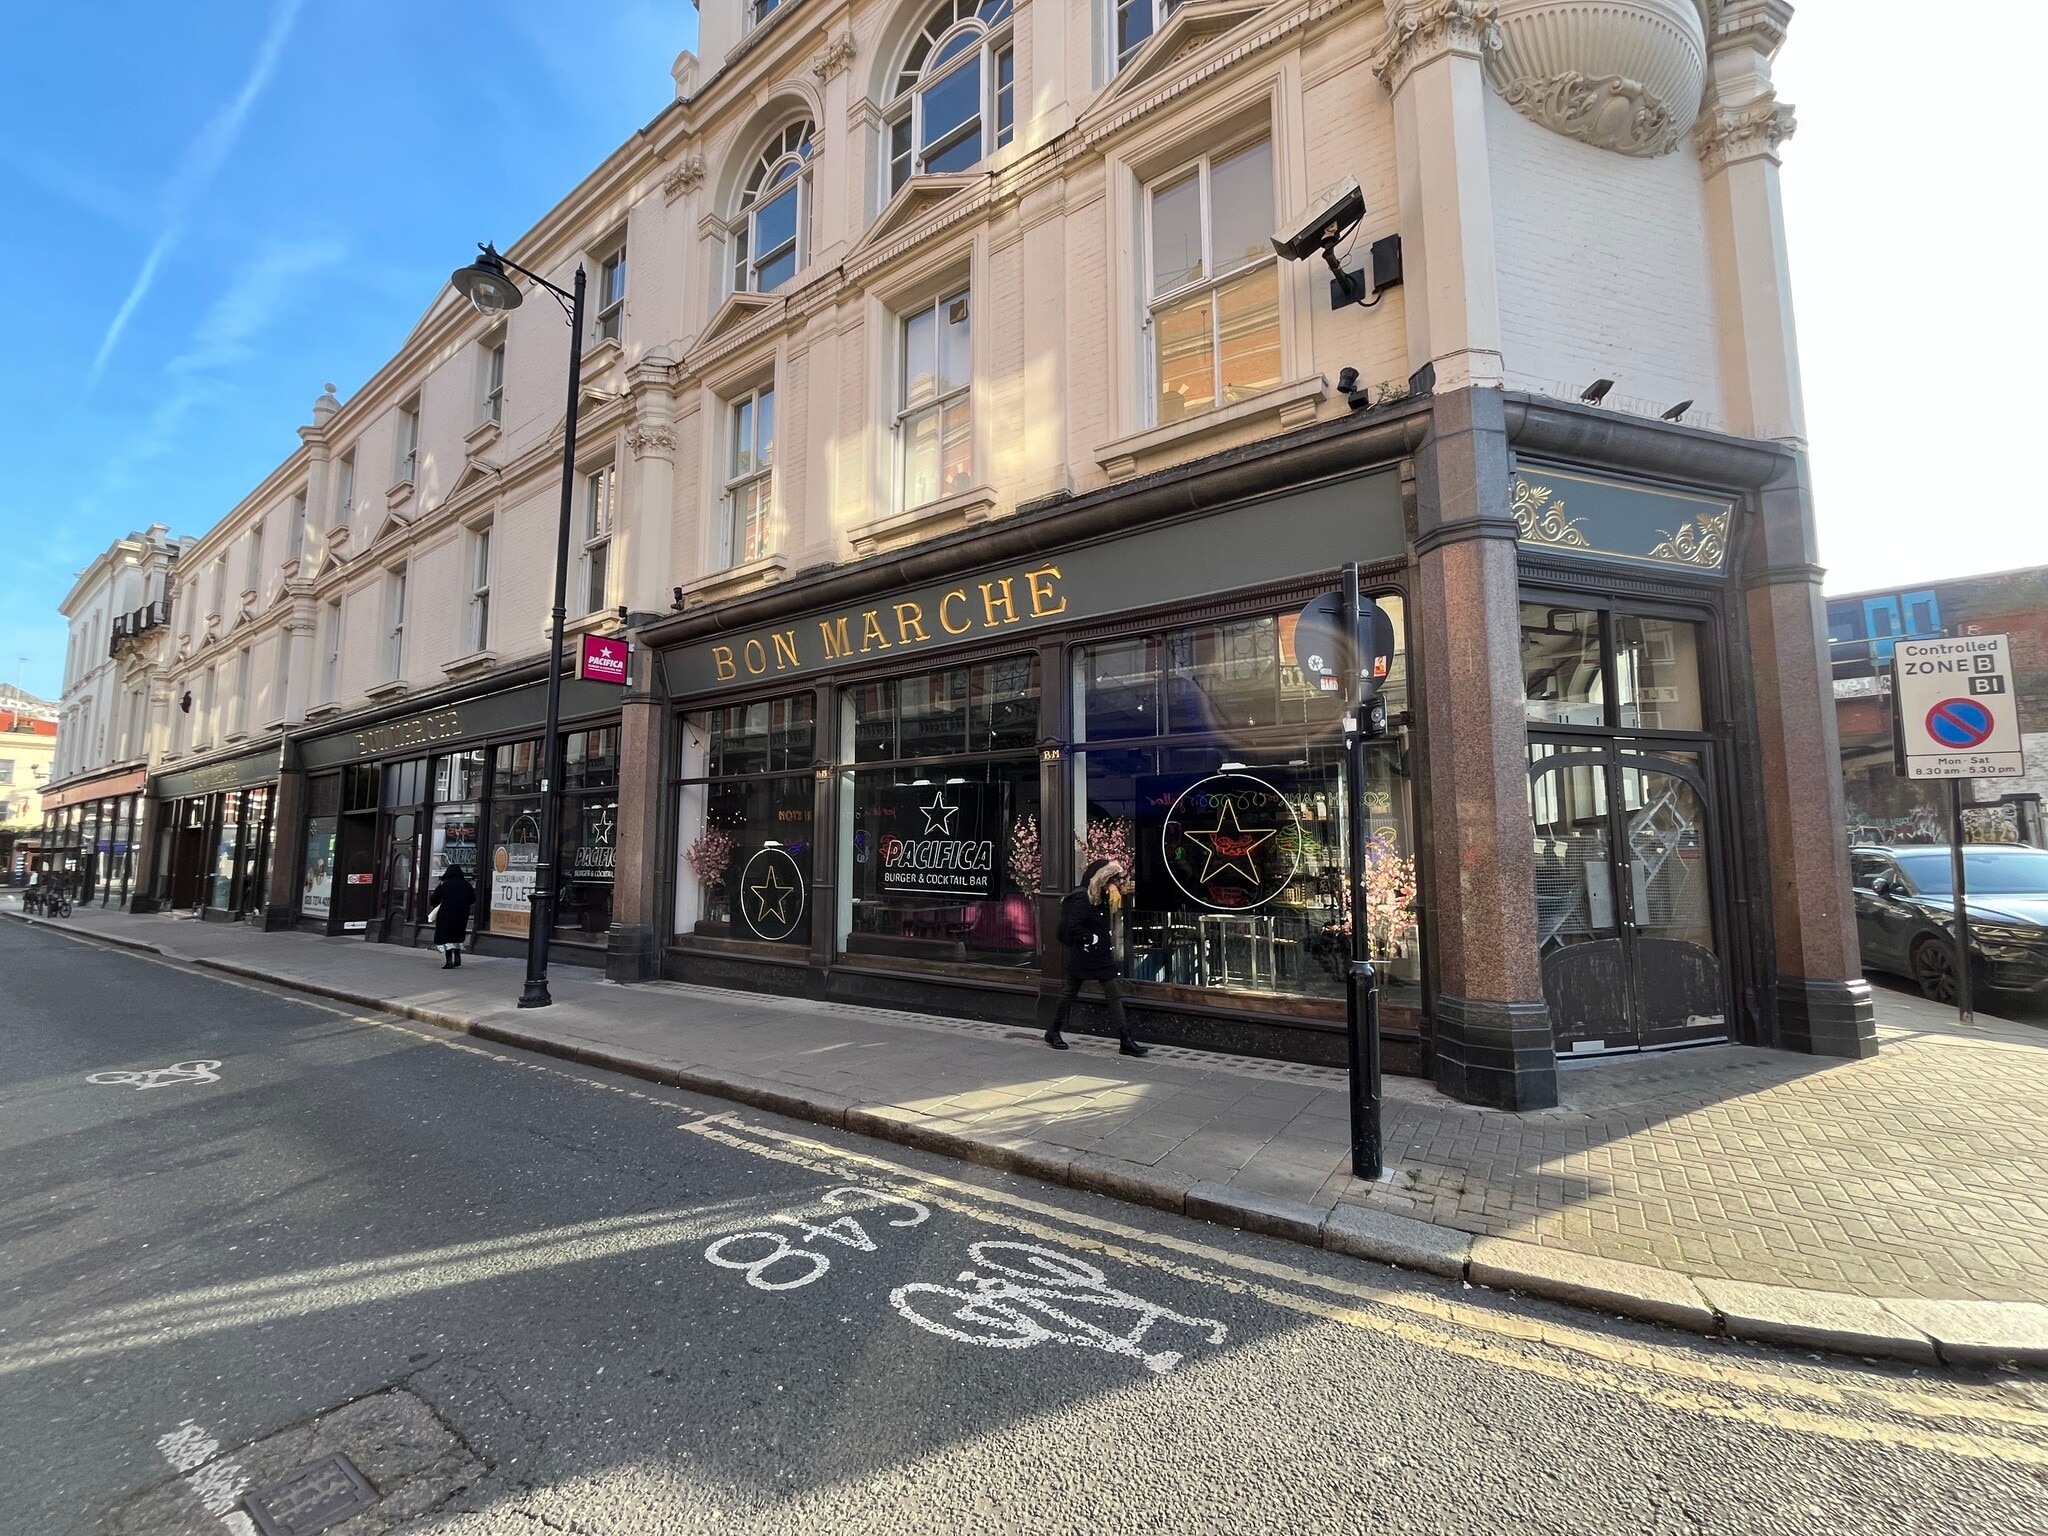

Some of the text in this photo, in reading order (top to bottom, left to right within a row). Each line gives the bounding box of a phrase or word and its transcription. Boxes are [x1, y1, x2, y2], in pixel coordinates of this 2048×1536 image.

[711, 630, 800, 681] BON
[1906, 640, 1998, 656] Controlled
[588, 656, 624, 669] PACIFICA
[1904, 657, 1992, 675] ZONE B
[1938, 757, 1961, 765] Mon
[1998, 766, 2015, 774] pm
[575, 847, 617, 867] PACIFIC
[886, 840, 992, 870] PACIFICA
[885, 872, 988, 886] BURGER & COCKTAIL BAR
[501, 886, 512, 901] TO
